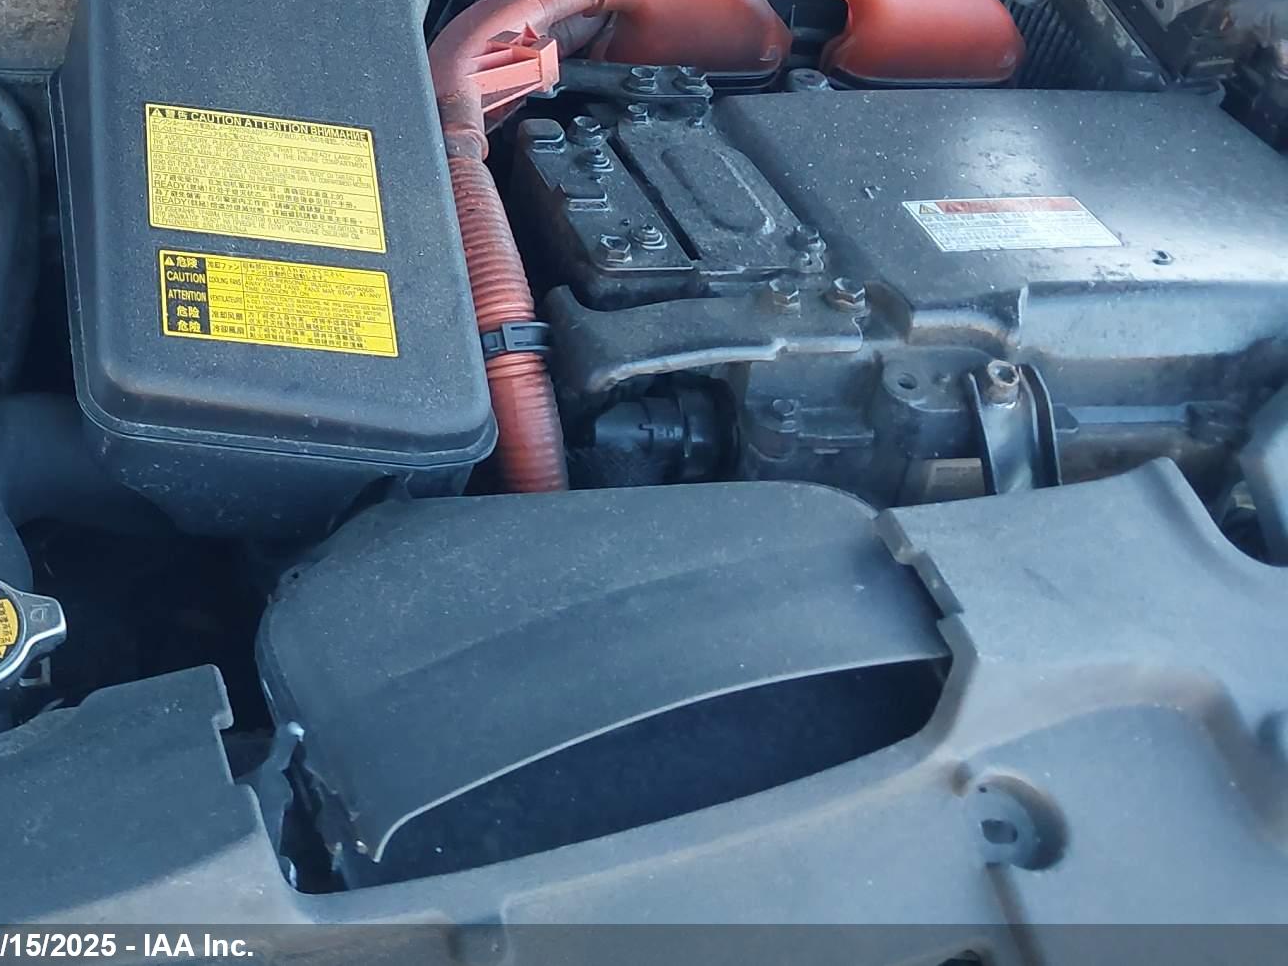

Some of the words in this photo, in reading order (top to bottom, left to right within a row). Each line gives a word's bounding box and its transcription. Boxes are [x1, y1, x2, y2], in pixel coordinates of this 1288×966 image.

[190, 112, 241, 126] CAUTION
[244, 118, 308, 134] ATTENTION
[310, 126, 368, 141] ВНИМАНИЕ
[166, 270, 205, 284] CAUTION
[167, 288, 206, 302] ATTENTION
